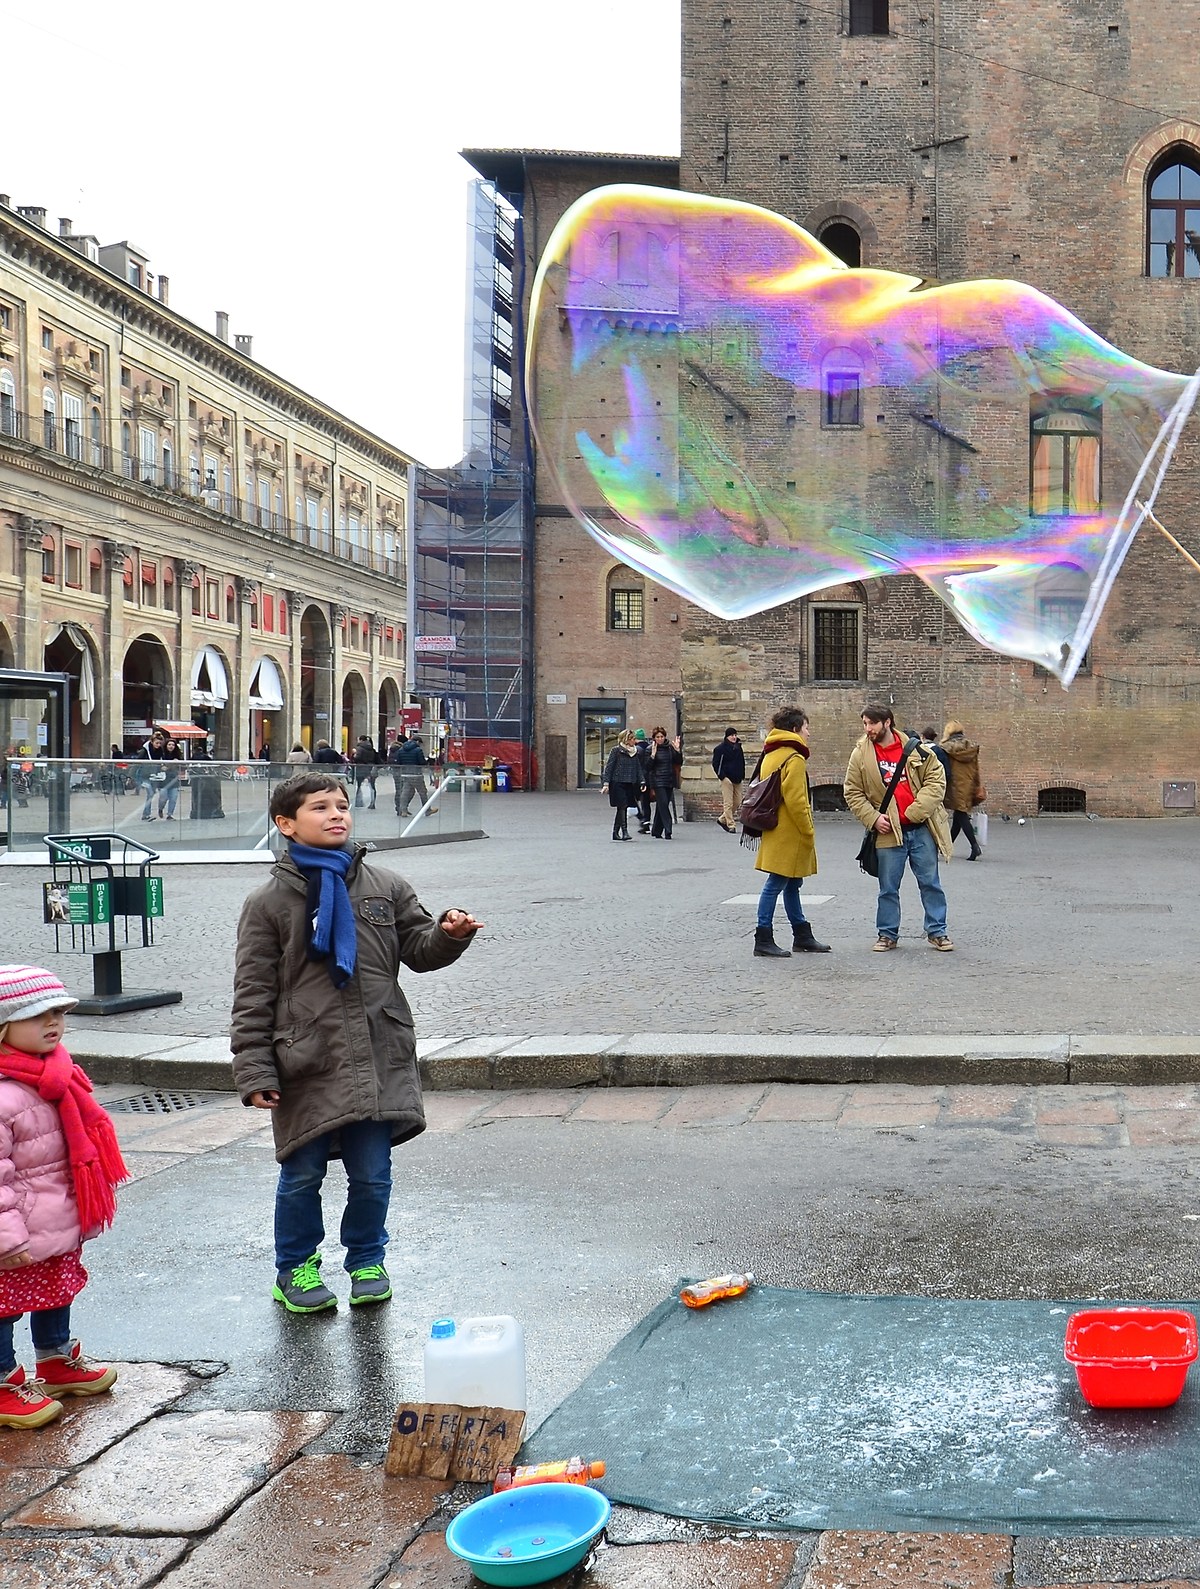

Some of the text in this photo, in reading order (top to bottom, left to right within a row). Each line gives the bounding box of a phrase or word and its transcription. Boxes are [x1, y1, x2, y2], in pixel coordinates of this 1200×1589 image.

[96, 883, 105, 920] metro
[149, 878, 158, 914] metro
[397, 1410, 507, 1440] OFFERTA
